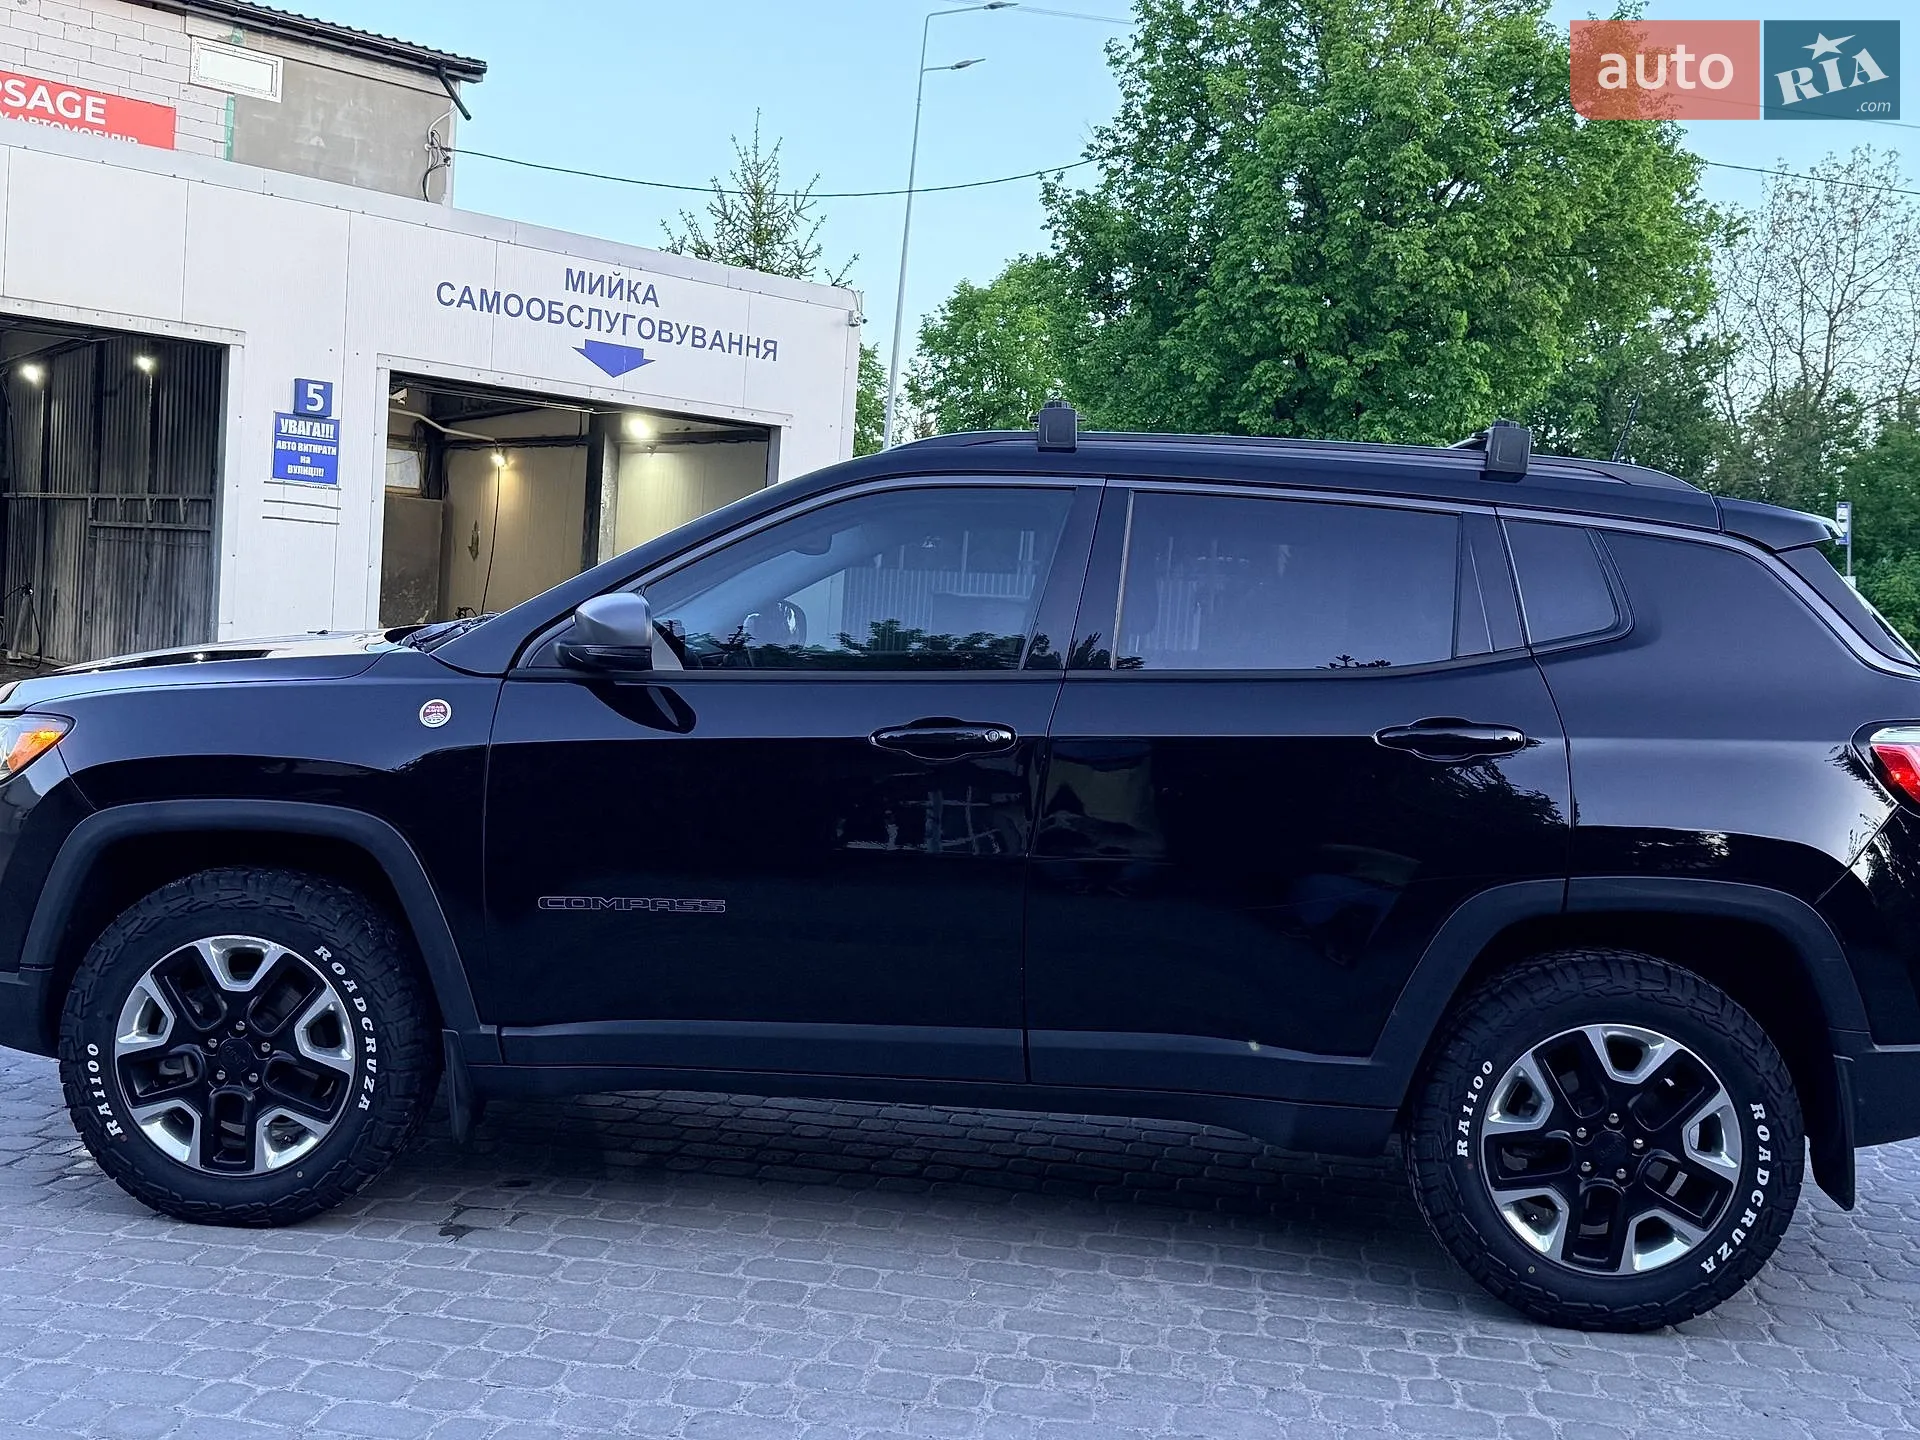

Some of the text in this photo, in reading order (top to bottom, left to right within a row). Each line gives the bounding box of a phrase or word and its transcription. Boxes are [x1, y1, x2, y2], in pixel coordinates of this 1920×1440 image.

[0, 79, 107, 125] SAGE
[565, 268, 659, 307] МИЙКА
[436, 282, 778, 361] САМООБСЛУГОВУВАННЯ
[306, 384, 324, 412] 5
[276, 440, 297, 452] АВТО
[280, 419, 335, 438] УВАГА!!!
[300, 456, 311, 464] на
[538, 896, 725, 913] COMPASS
[314, 945, 377, 1111] ROADCRUZA
[87, 1043, 123, 1137] RA1100
[1456, 1060, 1493, 1158] RA1100
[1700, 1103, 1772, 1275] ROADCRUZA
